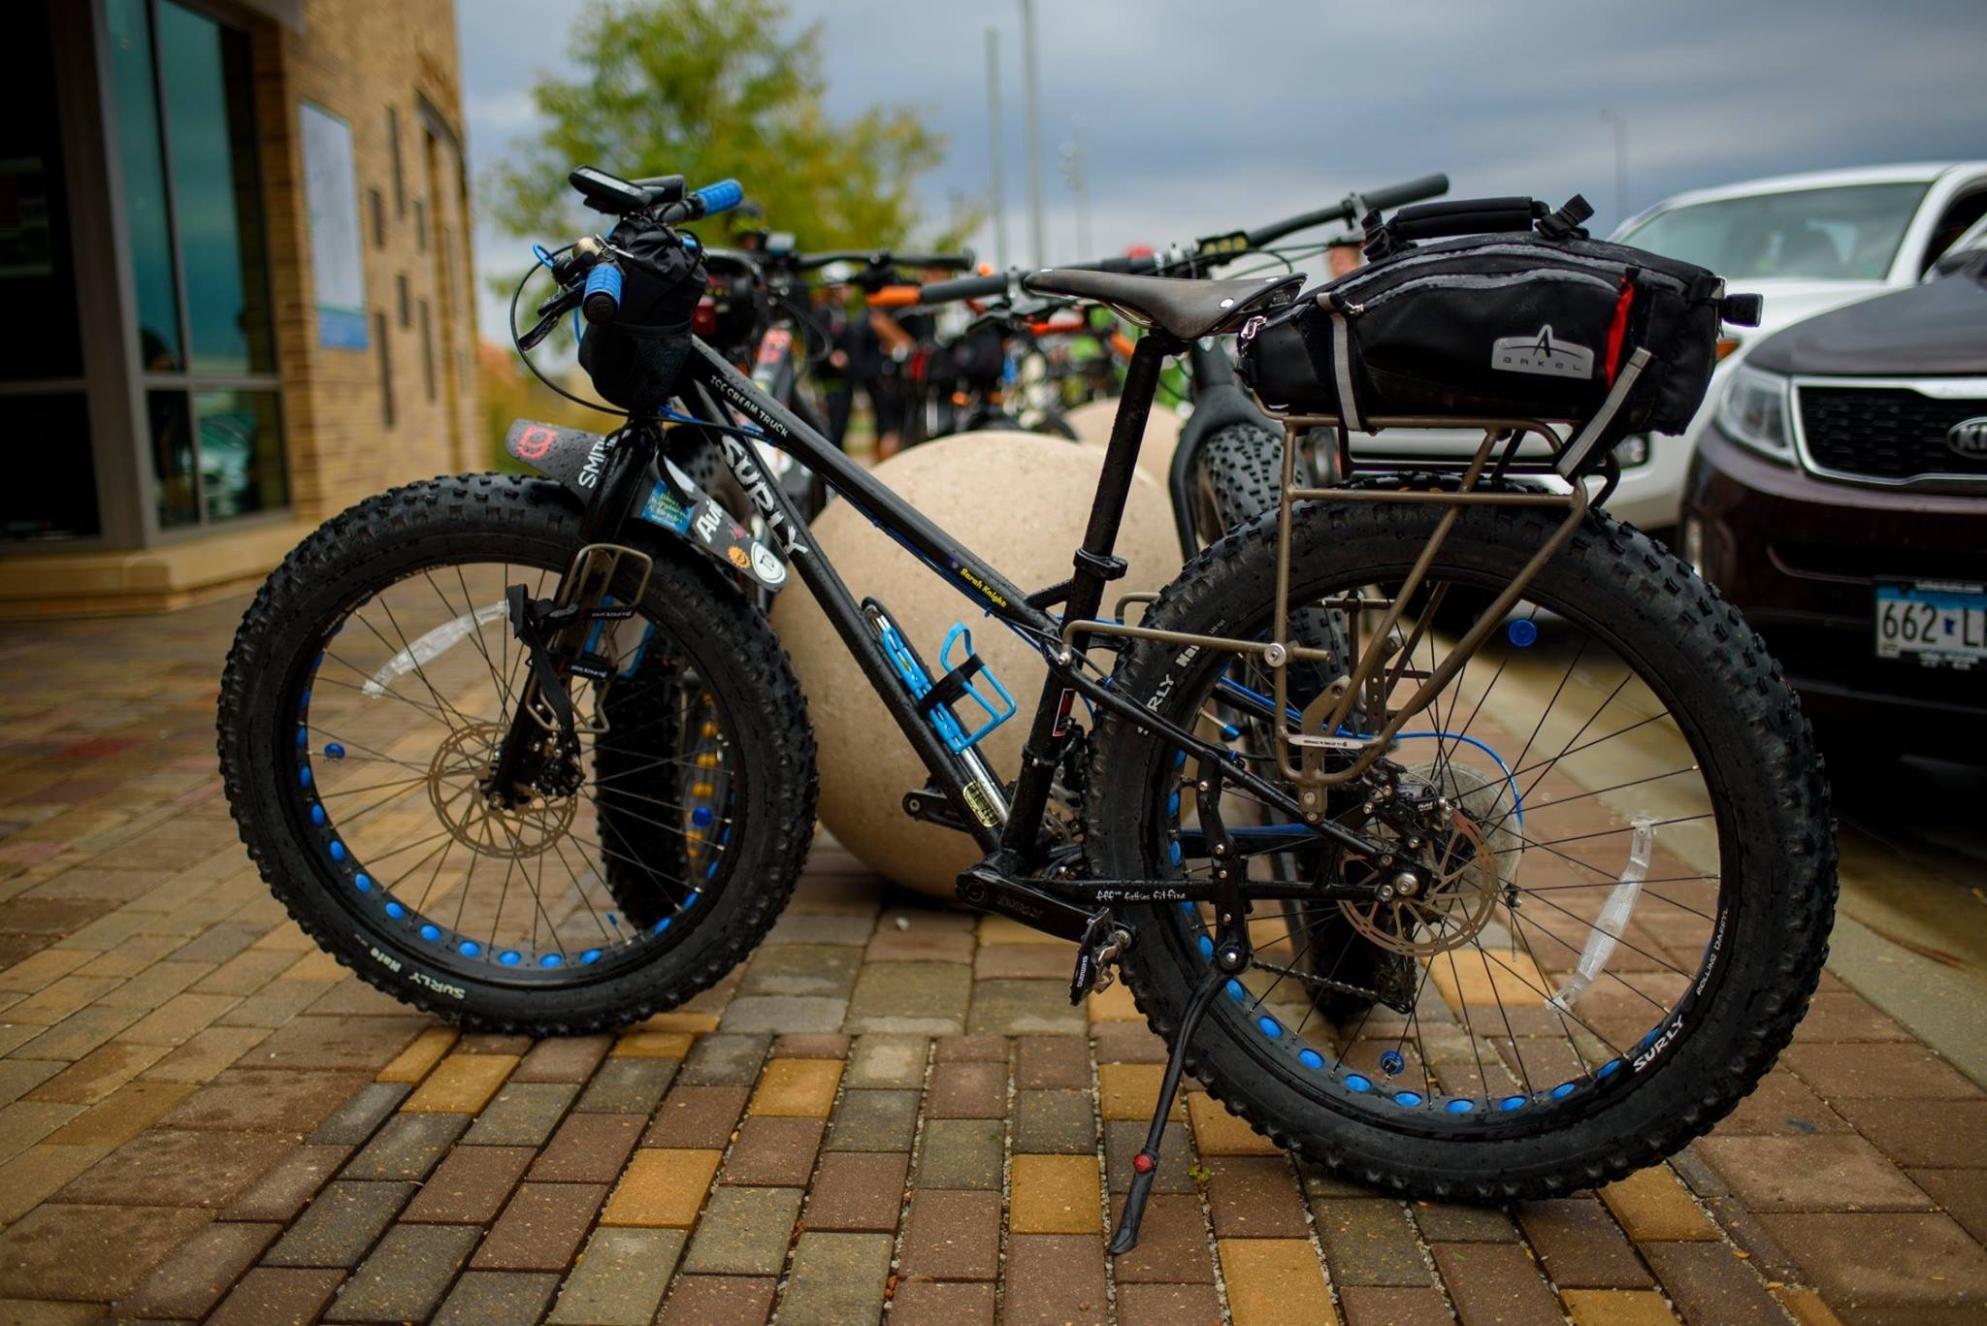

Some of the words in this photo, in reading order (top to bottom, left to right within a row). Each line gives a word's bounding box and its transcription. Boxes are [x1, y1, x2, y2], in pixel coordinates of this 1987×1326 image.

[727, 387, 759, 414] CREAM
[759, 410, 789, 437] TRUCK
[1957, 424, 1987, 451] KI
[721, 434, 809, 554] SURLY
[960, 568, 983, 589] Sarah
[1882, 602, 1938, 643] 662
[408, 972, 466, 1000] SURLY
[1632, 1014, 1685, 1073] SURLY
